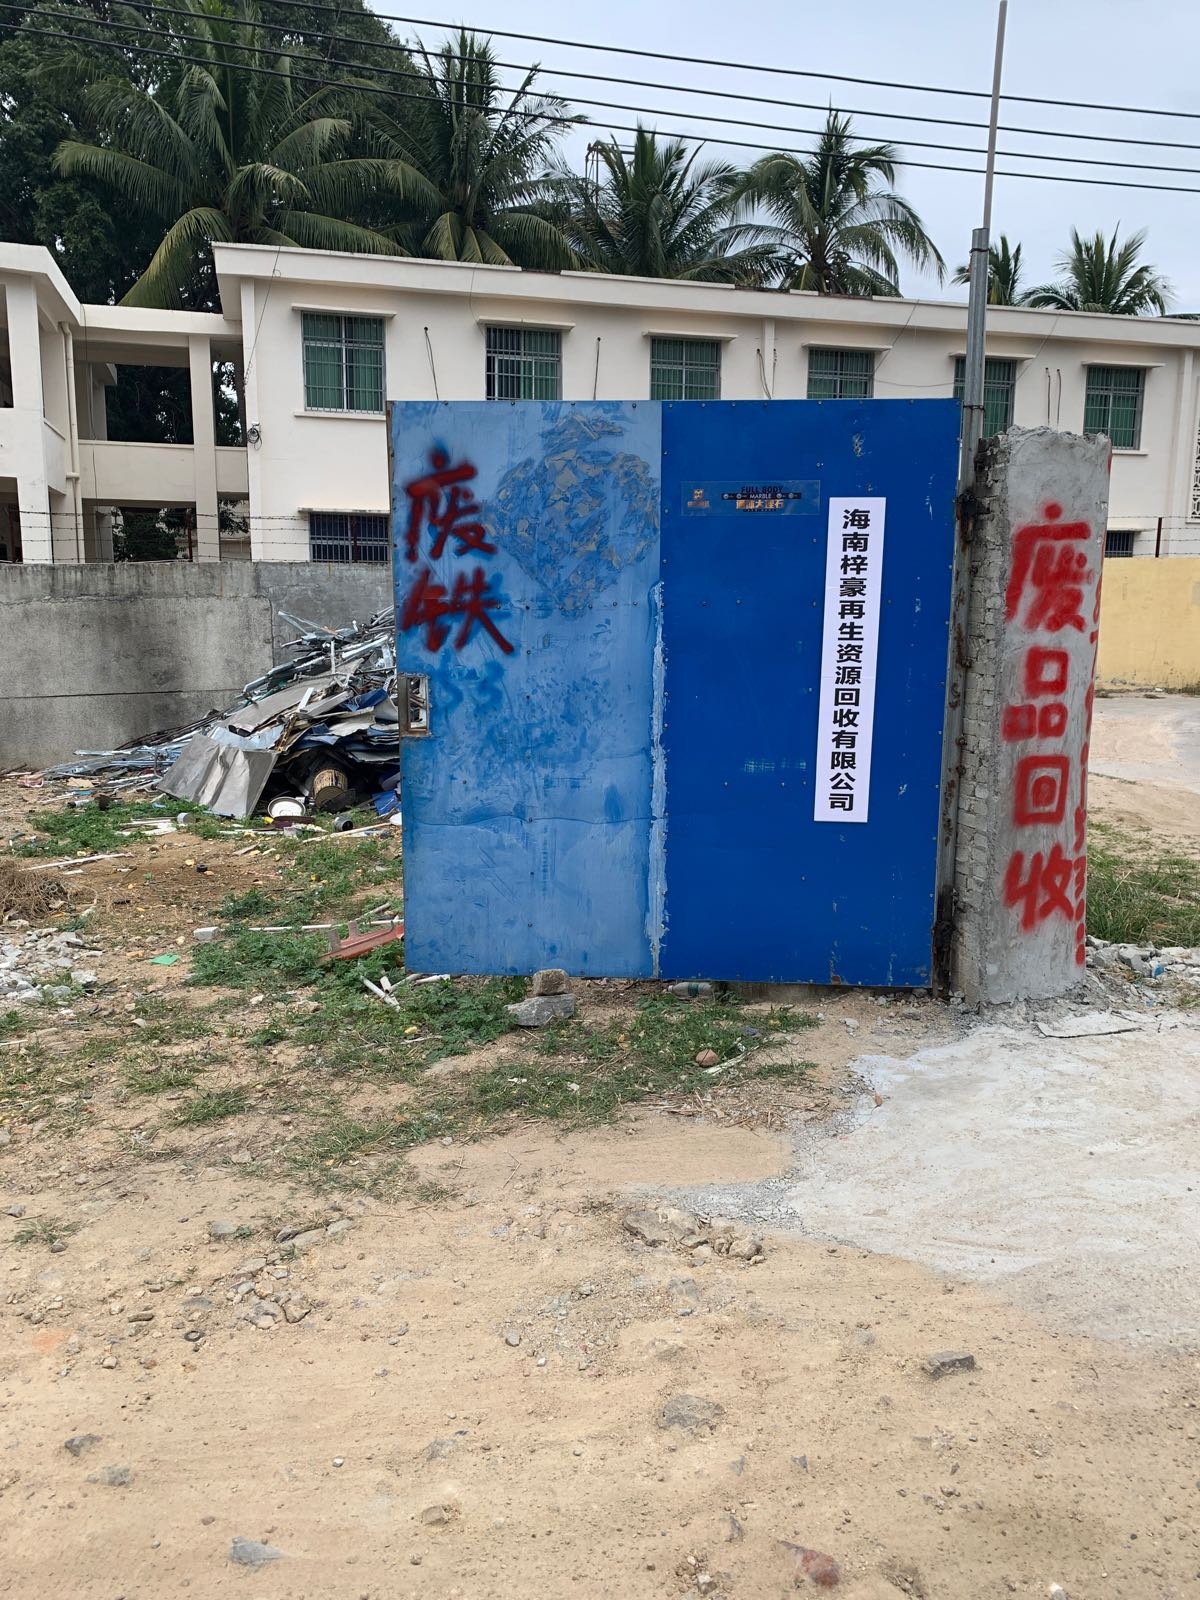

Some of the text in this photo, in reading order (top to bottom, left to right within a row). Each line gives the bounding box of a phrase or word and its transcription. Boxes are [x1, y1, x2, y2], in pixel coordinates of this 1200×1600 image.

[402, 447, 515, 655] 废铁
[741, 486, 784, 494] FULL BODY
[829, 508, 871, 812] 海南梓豪再生资源回收有限公司
[1002, 502, 1092, 933] 废品回收
